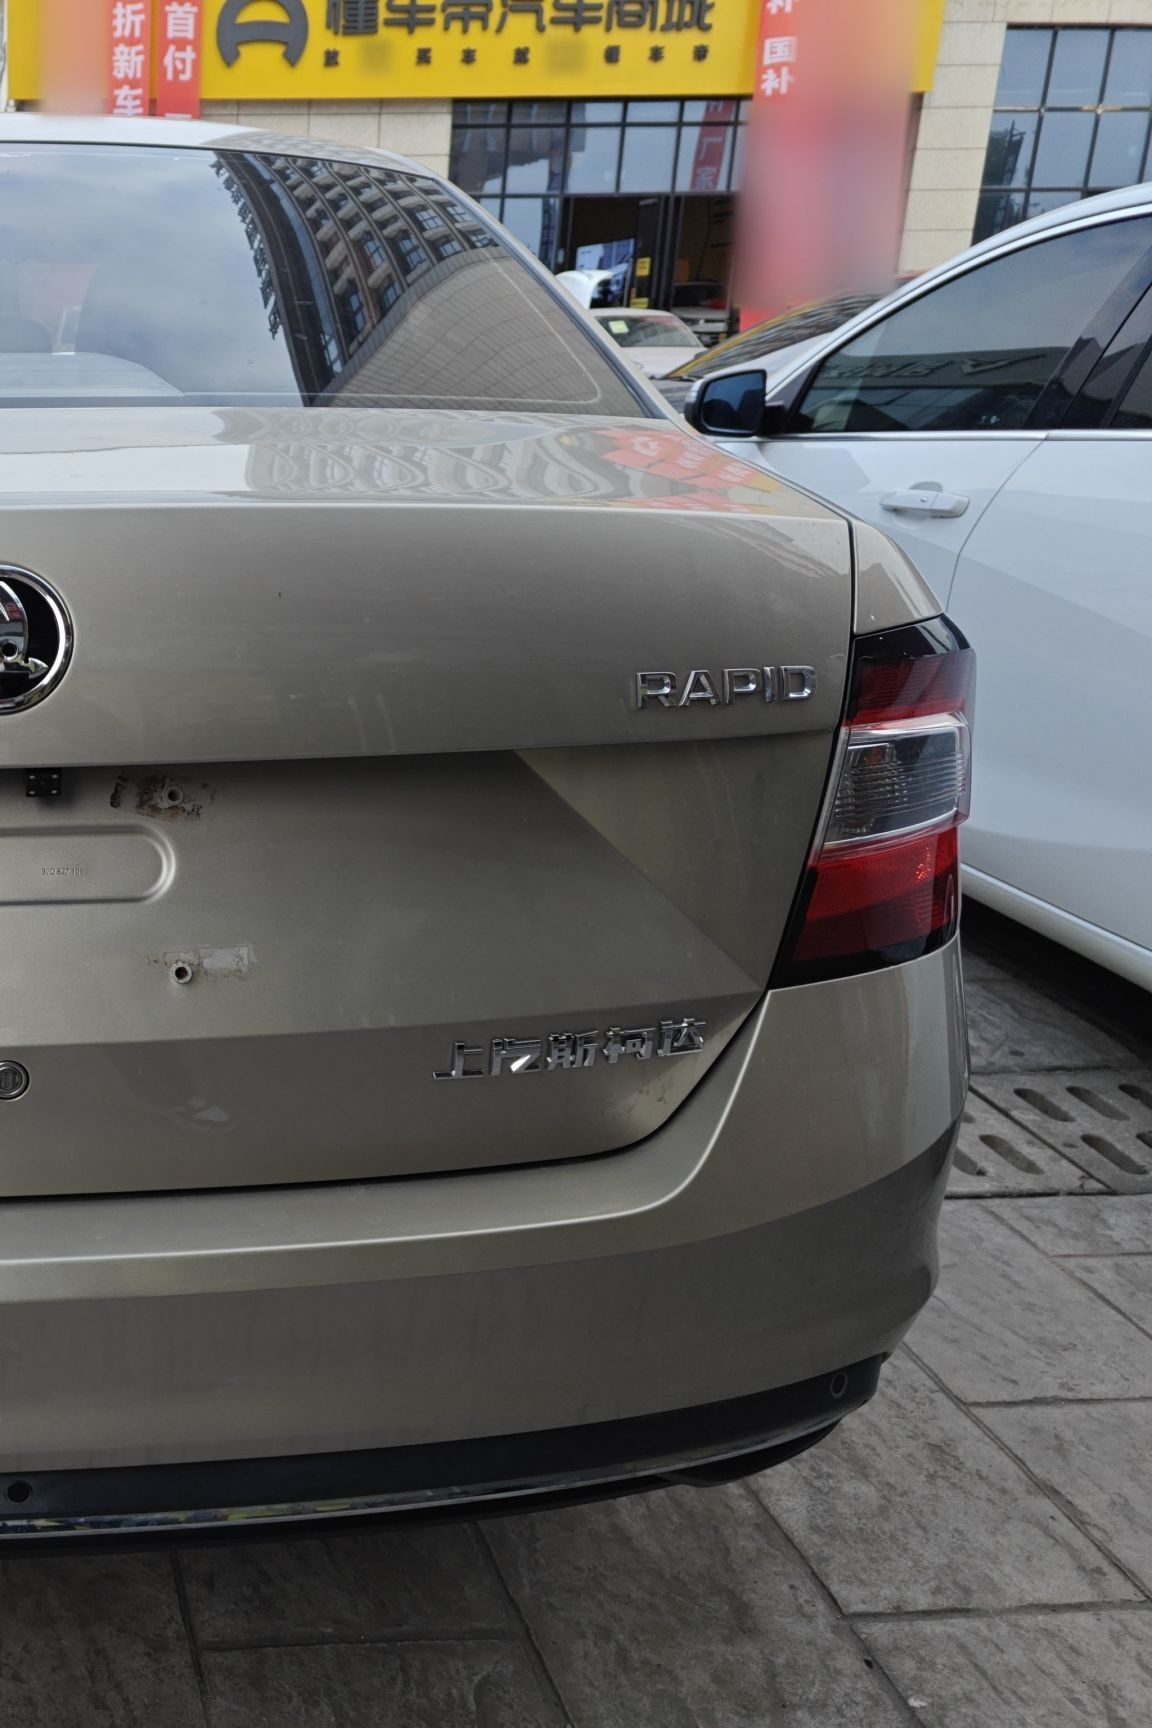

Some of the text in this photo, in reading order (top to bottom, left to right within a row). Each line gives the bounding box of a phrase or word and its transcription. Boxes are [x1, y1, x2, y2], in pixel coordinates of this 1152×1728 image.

[636, 665, 817, 709] RAPID
[433, 1018, 707, 1080] 上汽斯柯达
